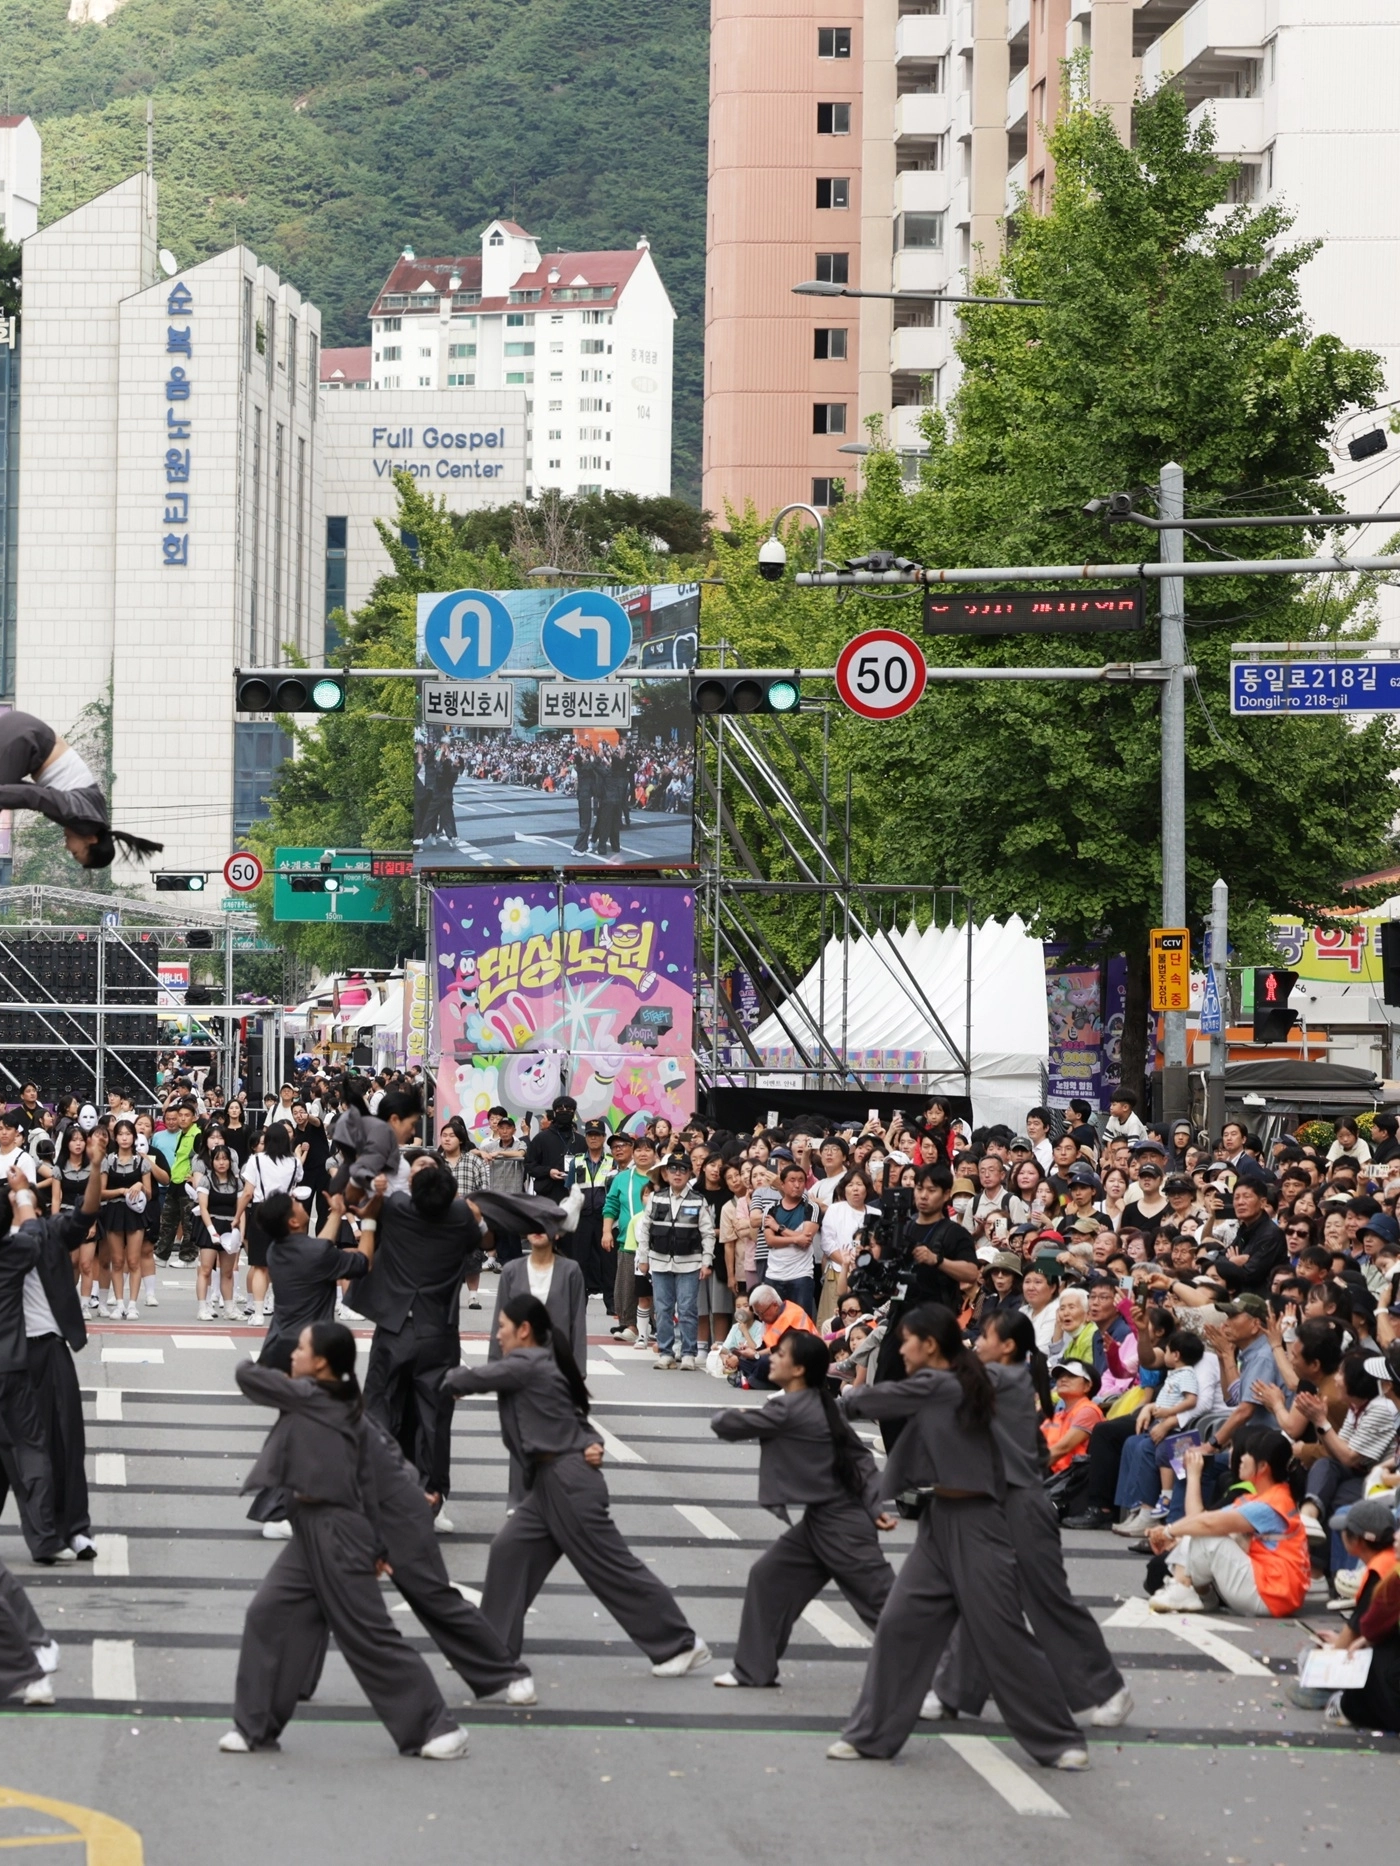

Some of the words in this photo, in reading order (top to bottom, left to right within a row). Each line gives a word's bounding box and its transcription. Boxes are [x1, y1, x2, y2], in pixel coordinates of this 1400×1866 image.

[163, 281, 193, 567] 순복음노원교회
[372, 427, 413, 449] Full
[422, 427, 504, 451] Gospel
[436, 459, 504, 478] Center
[856, 656, 908, 694] 50
[1240, 667, 1377, 692] 동일로218길
[427, 690, 509, 718] 보행신호시
[544, 691, 627, 718] 보행신호시
[1240, 695, 1301, 709] Dongil-ro
[1304, 694, 1348, 708] 218-gil
[232, 864, 254, 881] 50
[325, 912, 343, 920] 150m
[1163, 939, 1181, 948] CCTV
